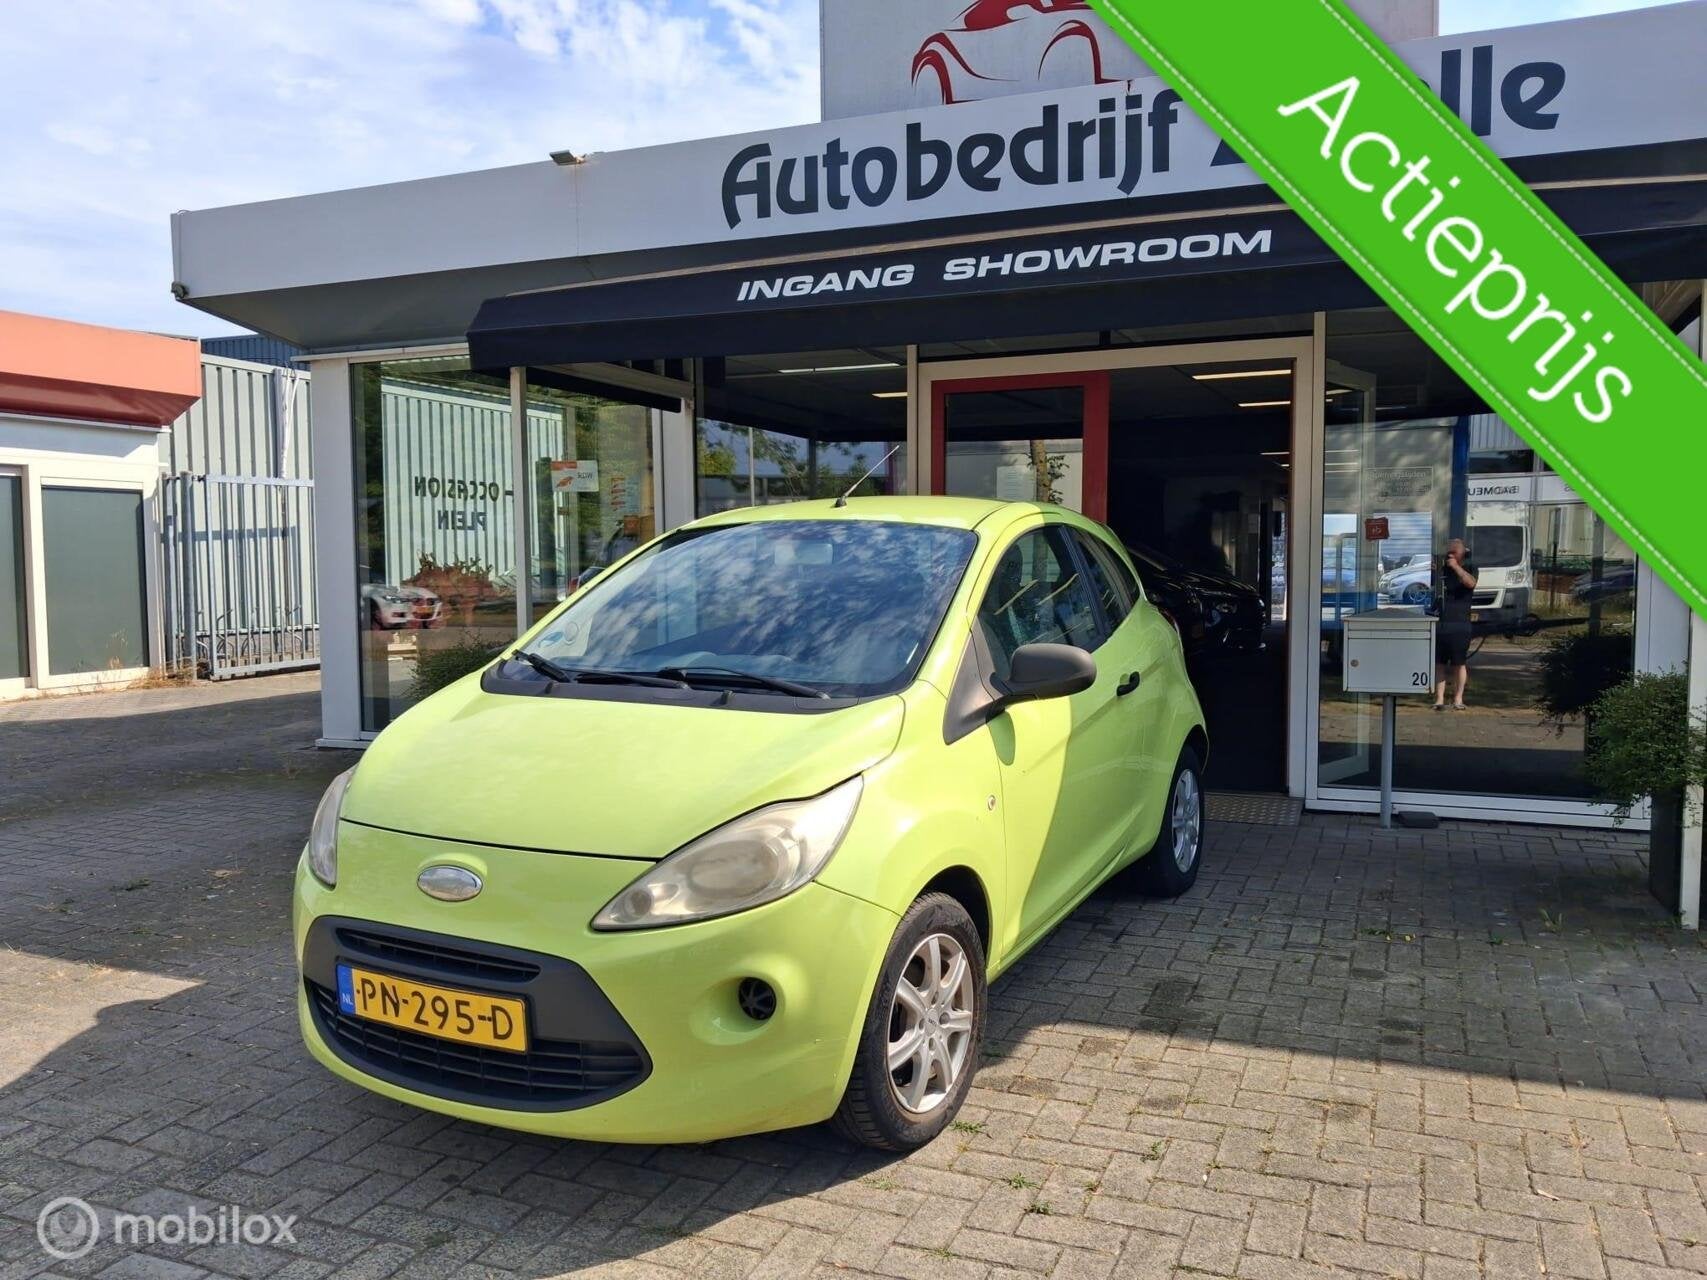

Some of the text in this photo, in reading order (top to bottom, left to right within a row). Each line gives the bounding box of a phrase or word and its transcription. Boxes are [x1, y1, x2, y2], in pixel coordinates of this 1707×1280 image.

[721, 88, 1184, 230] Autobedrijf
[737, 229, 1273, 301] INGANG SHOWROOM
[1412, 672, 1428, 686] 20
[342, 993, 353, 1005] NL
[360, 977, 513, 1041] PN-295-D
